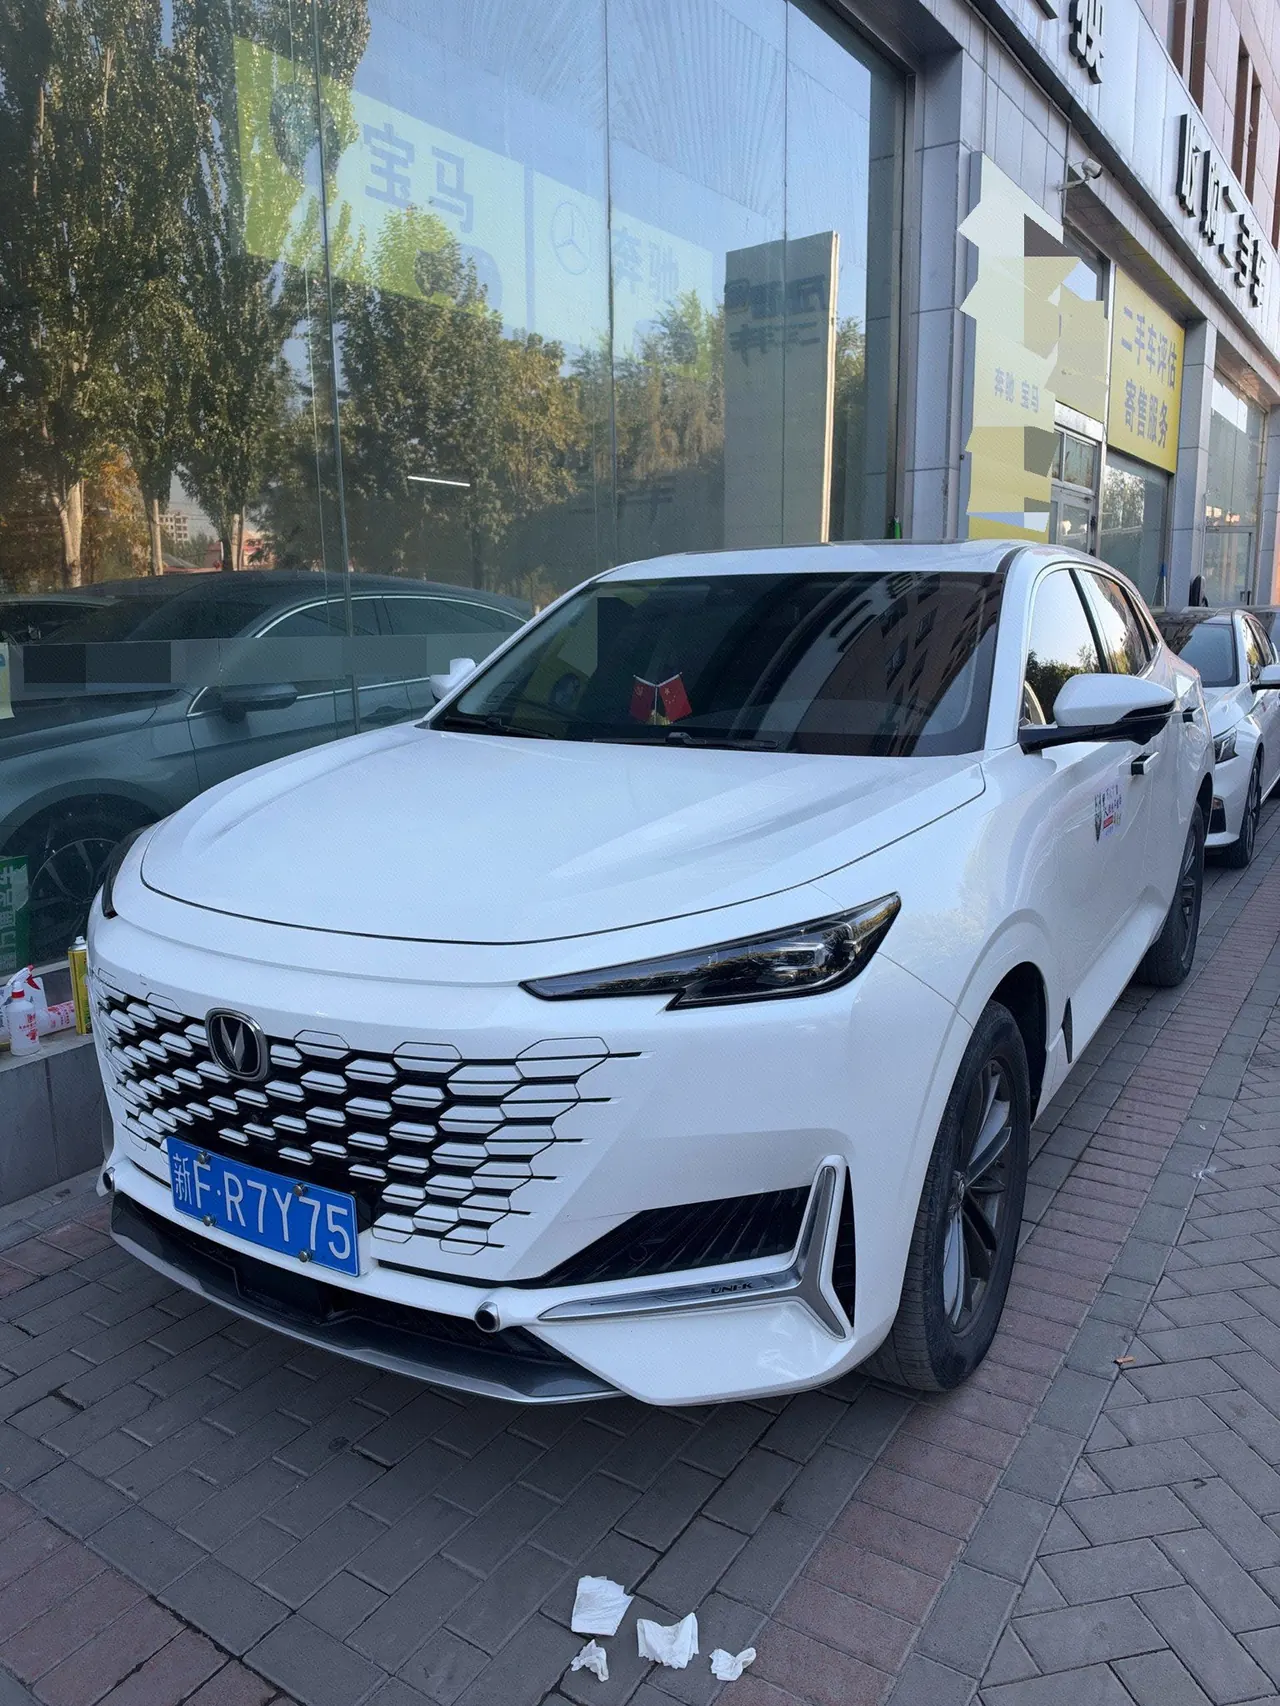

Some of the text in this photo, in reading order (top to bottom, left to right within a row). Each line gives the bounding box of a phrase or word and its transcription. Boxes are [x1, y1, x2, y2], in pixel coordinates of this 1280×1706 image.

[363, 122, 474, 234] 宝马
[1121, 305, 1177, 391] 二手车评估
[1124, 378, 1168, 449] 寄售服务
